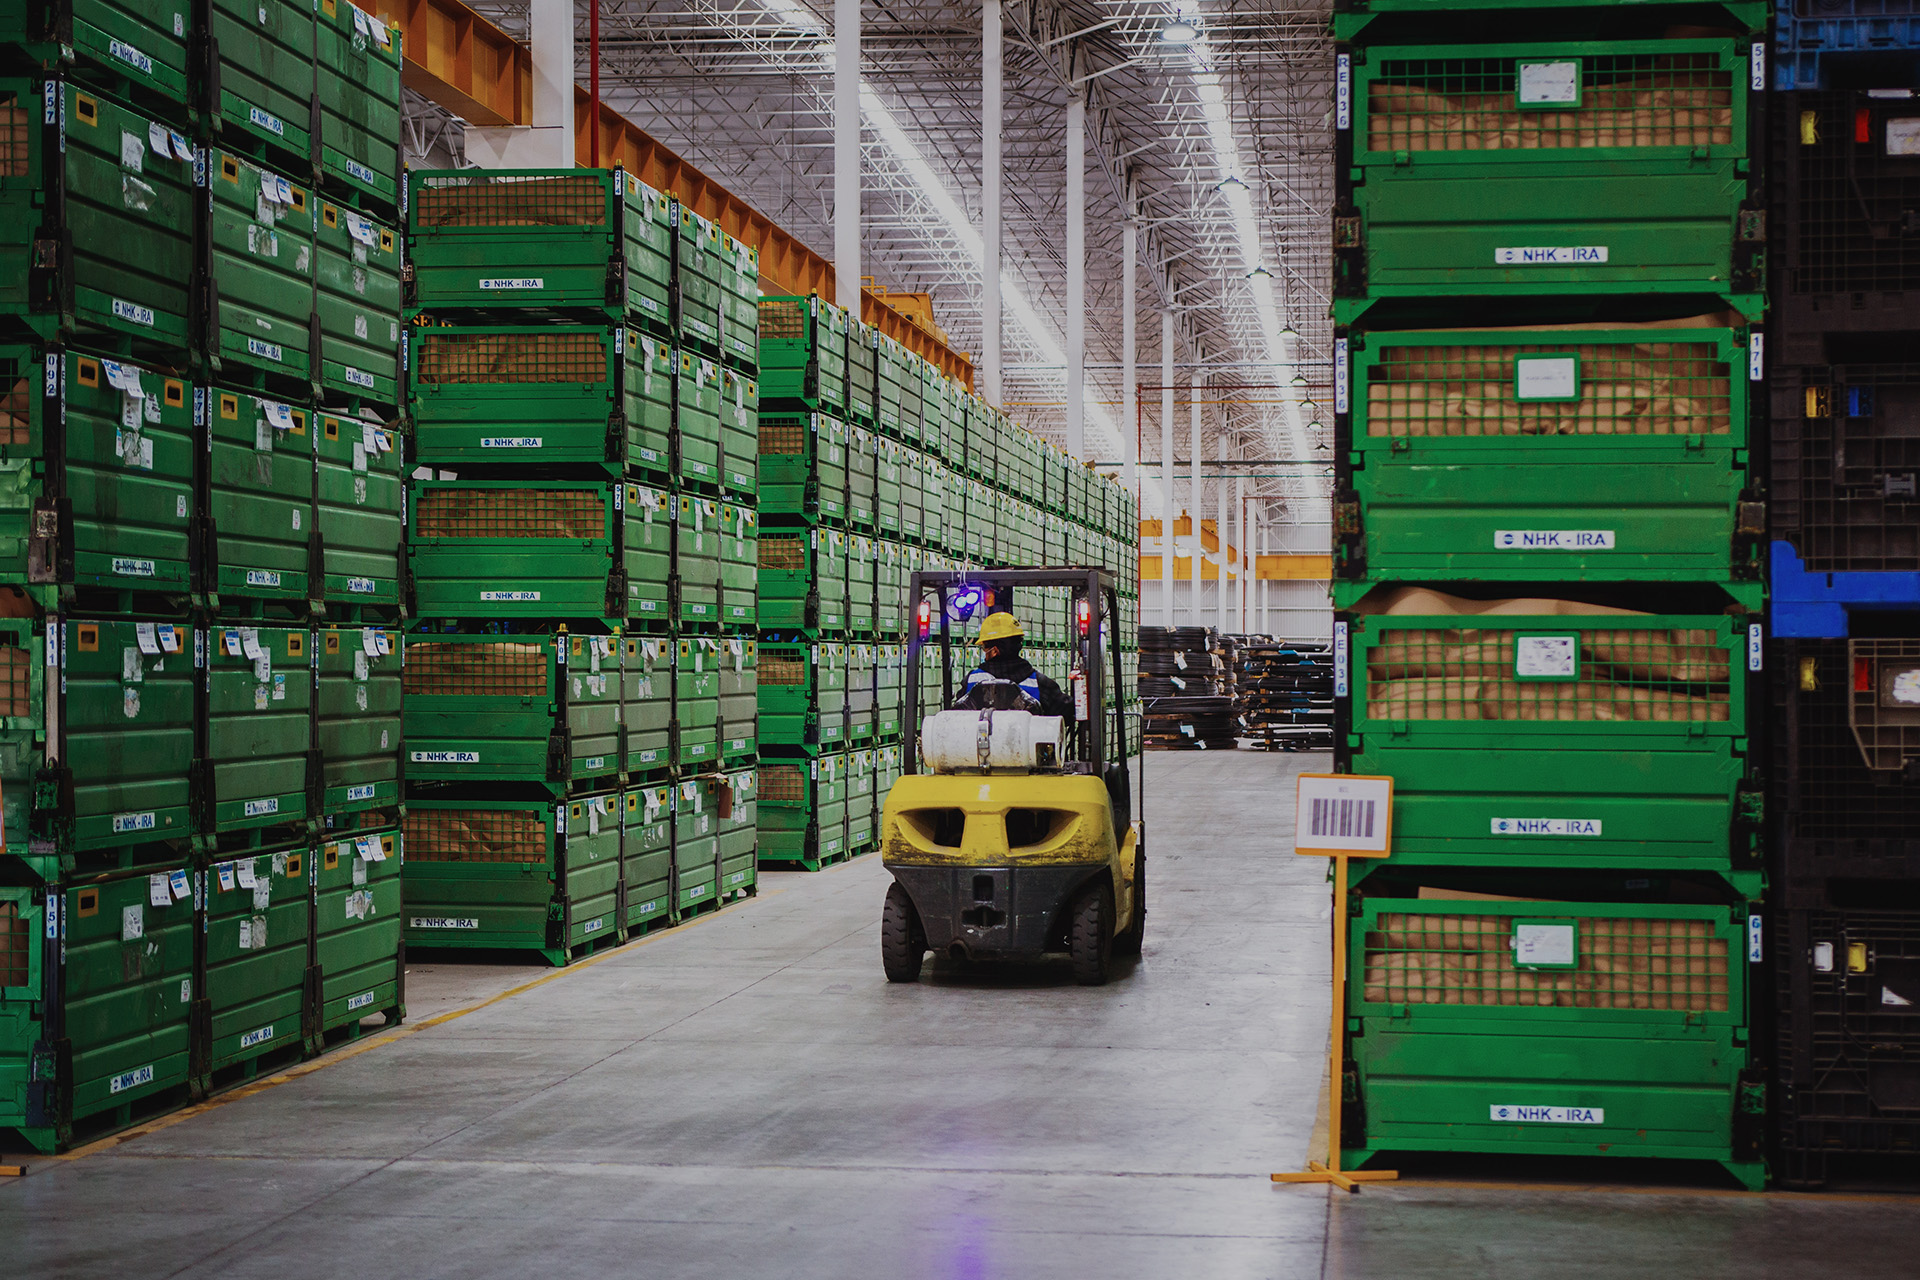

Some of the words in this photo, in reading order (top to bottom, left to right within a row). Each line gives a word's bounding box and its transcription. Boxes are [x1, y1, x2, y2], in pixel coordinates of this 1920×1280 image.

[119, 46, 133, 63] NHK
[138, 55, 149, 72] IRA
[1754, 46, 1762, 87] 512
[1338, 58, 1348, 125] RE036
[46, 82, 54, 122] 257
[258, 115, 269, 127] NHK
[272, 120, 283, 133] IRA
[1523, 249, 1557, 261] NHK
[1573, 248, 1599, 260] IRA
[494, 280, 513, 288] NHK
[122, 303, 136, 318] NHK
[141, 310, 152, 323] IRA
[1337, 341, 1347, 409] RE036
[1523, 533, 1559, 545] NHK
[1576, 533, 1606, 546] IRA
[122, 561, 136, 570] NHK
[141, 562, 152, 572] IRA
[254, 573, 266, 583] NHK
[269, 574, 279, 584] IRA
[1752, 626, 1760, 668] 339
[1337, 625, 1346, 692] RE036
[427, 753, 448, 761] NHK
[457, 753, 473, 761] IRA
[123, 816, 136, 829] NHK
[142, 815, 152, 827] IRA
[1517, 820, 1550, 832] NHK
[1566, 821, 1595, 833] IRA
[426, 918, 447, 926] NHK
[456, 919, 473, 927] IRA
[1752, 918, 1760, 959] 614
[121, 1073, 135, 1088] NHK
[140, 1067, 151, 1082] IRA
[1517, 1108, 1552, 1120] NHK
[1567, 1108, 1594, 1121] IRA
